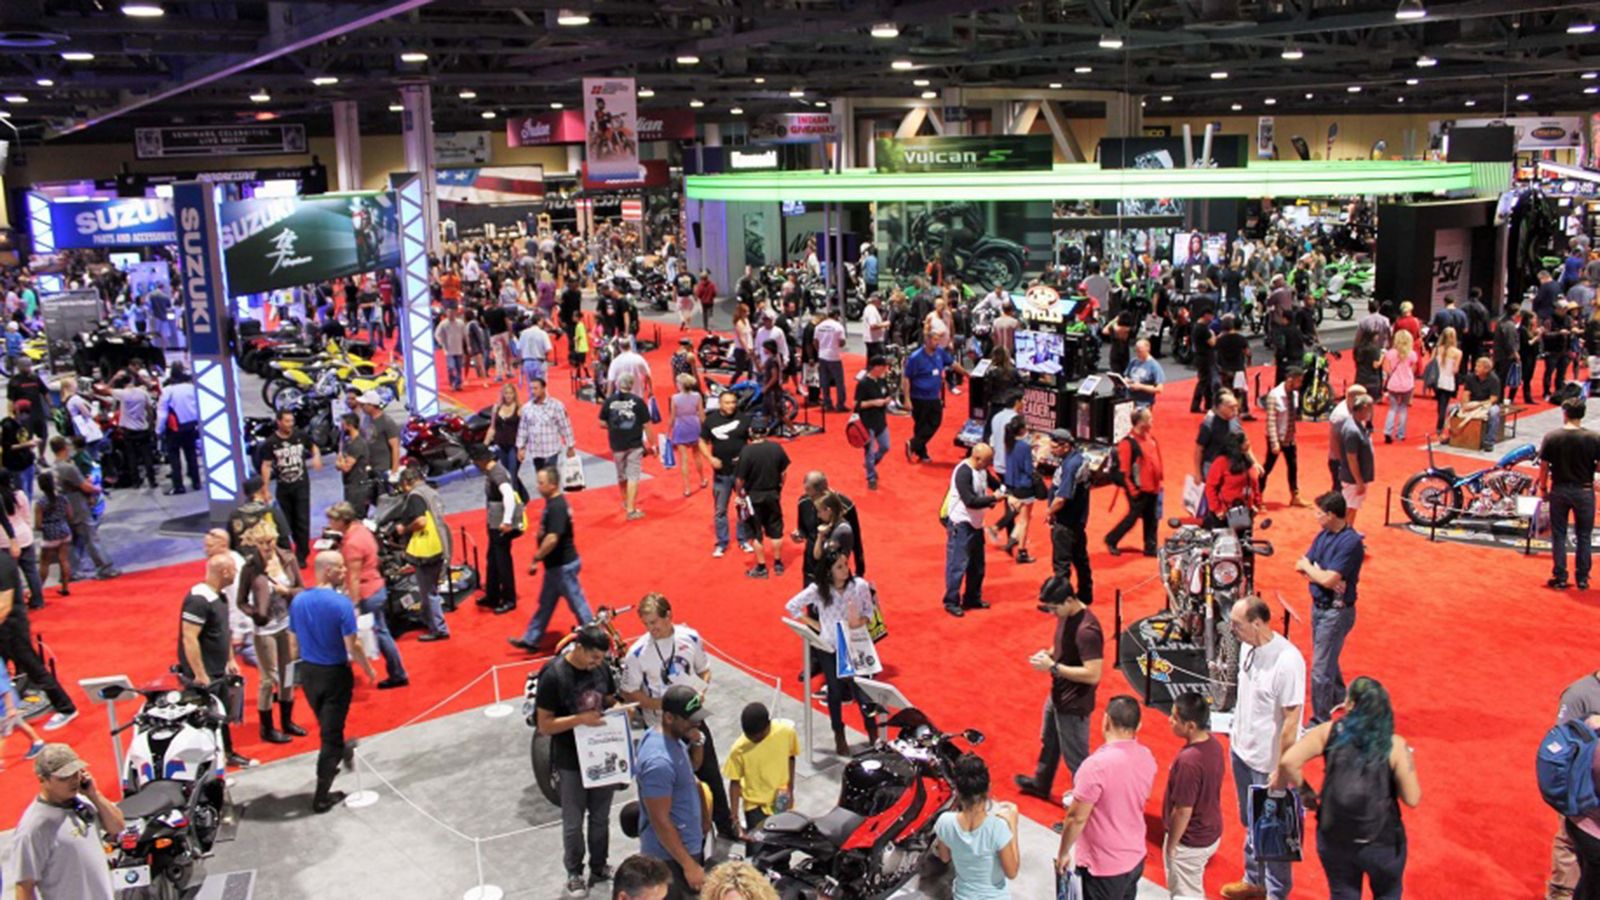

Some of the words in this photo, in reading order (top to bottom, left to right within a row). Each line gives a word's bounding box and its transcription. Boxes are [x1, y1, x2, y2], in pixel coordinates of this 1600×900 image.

[797, 115, 829, 124] INDIAN
[789, 125, 836, 134] GIVEAWAY
[904, 150, 977, 164] Vulcan
[982, 149, 1013, 162] S
[75, 199, 174, 234] SUZUK
[93, 234, 115, 244] PARTS
[116, 233, 131, 243] AND
[181, 207, 211, 334] SUZUKI
